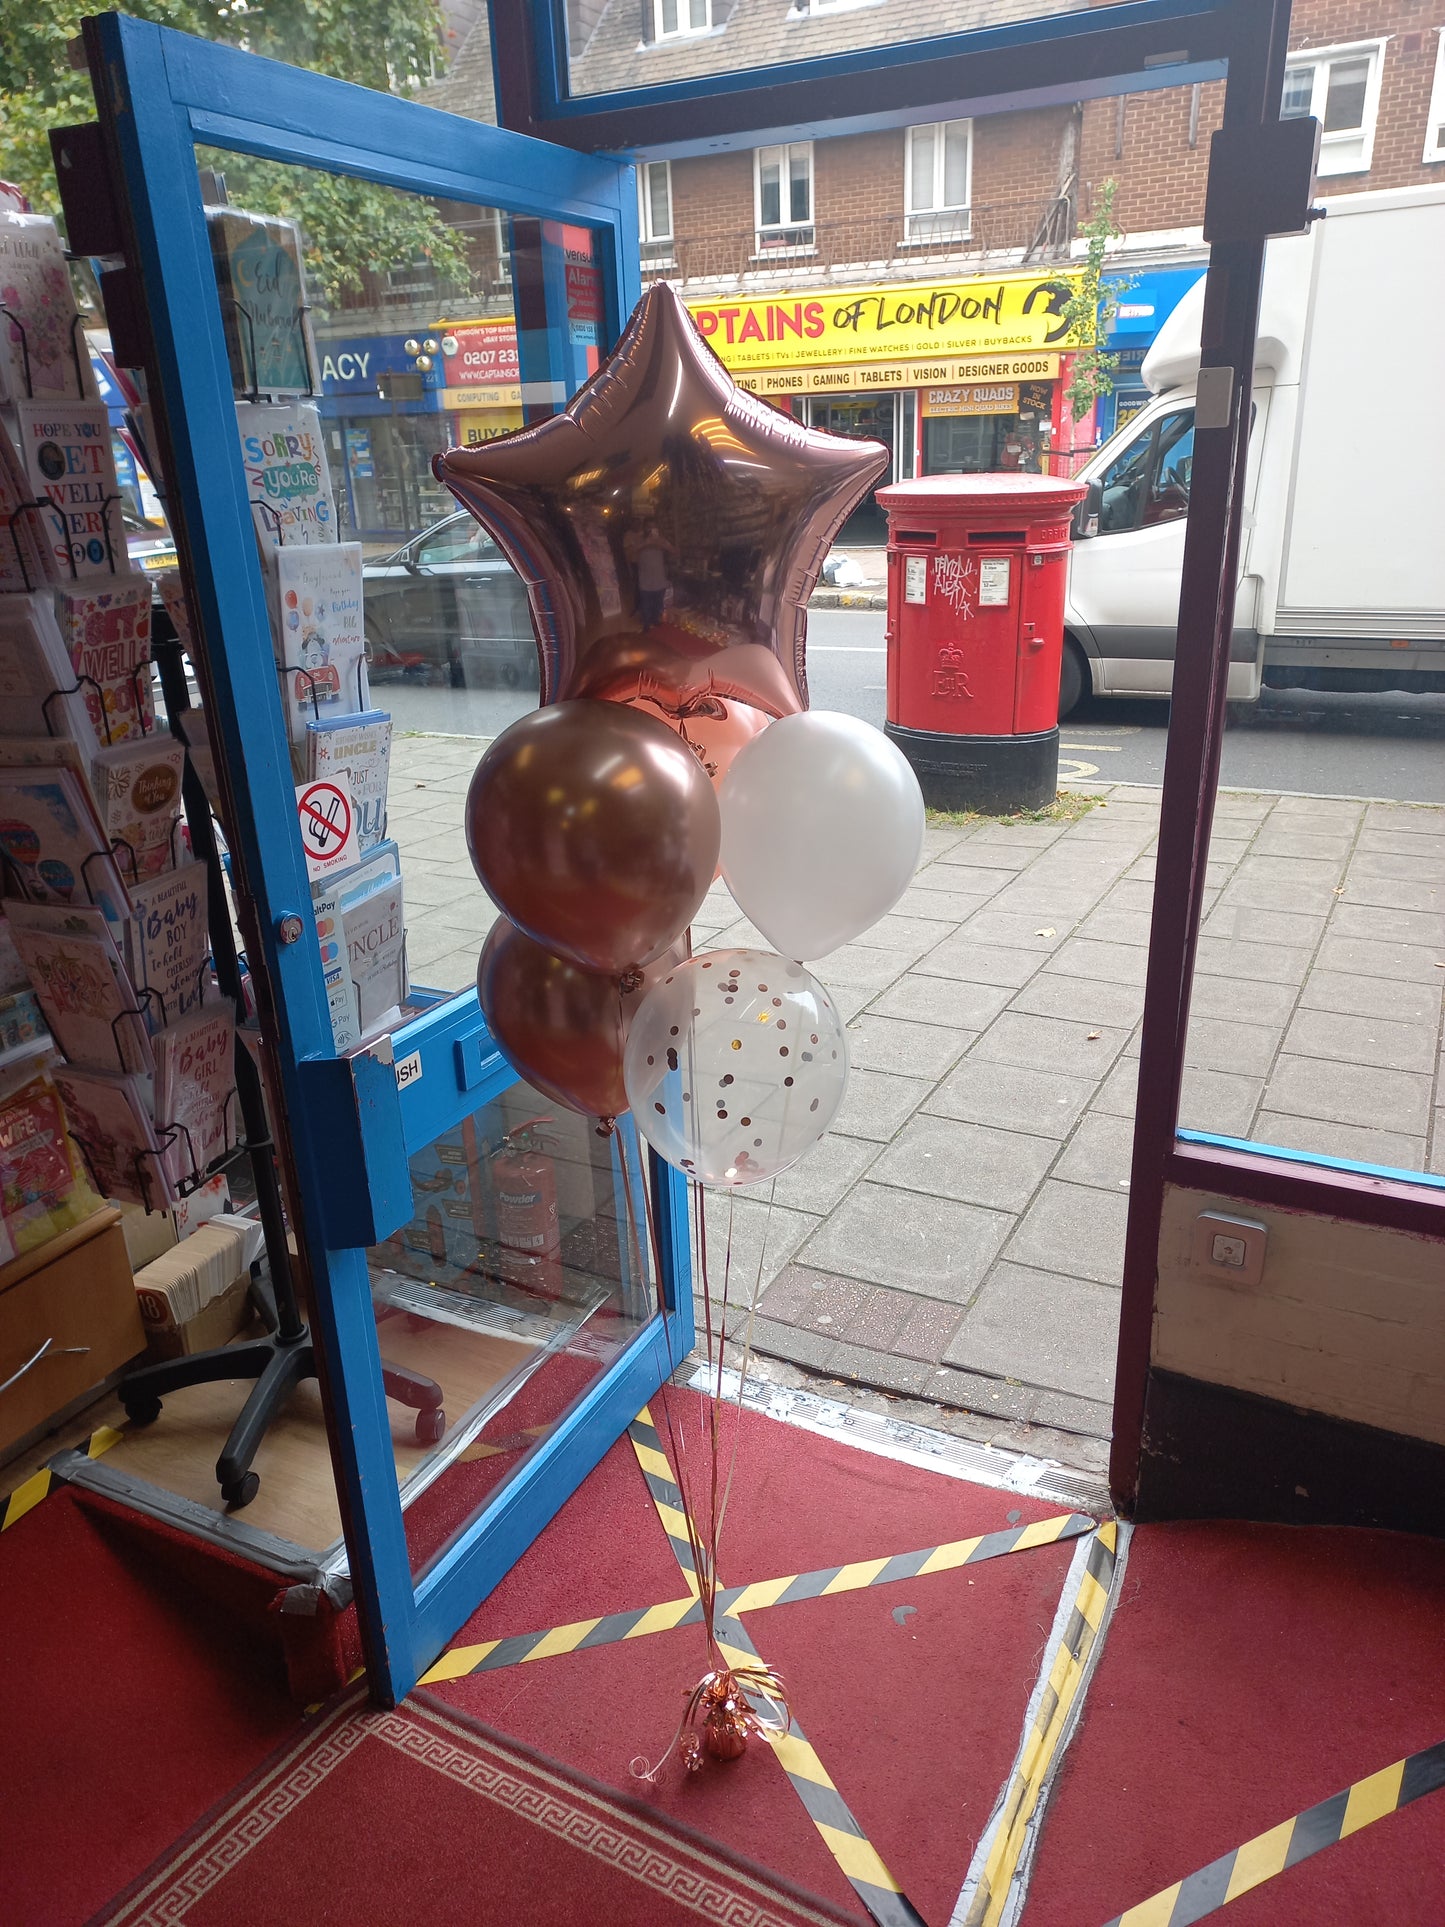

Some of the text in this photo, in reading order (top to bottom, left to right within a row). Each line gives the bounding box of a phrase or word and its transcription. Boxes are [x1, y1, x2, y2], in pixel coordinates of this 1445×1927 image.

[876, 286, 1005, 331] LONDON
[463, 350, 496, 365] 0207
[737, 353, 770, 361] TABLETS
[795, 349, 843, 358] JEWELLERY
[848, 346, 868, 355] FINE
[869, 344, 910, 353] WATCHES
[916, 341, 940, 350] GOLD
[946, 339, 977, 349] SILVER
[983, 335, 1033, 346] BUYBACKS
[766, 376, 803, 389] PHONES
[813, 373, 850, 386] GAMING
[860, 370, 902, 383] TABLETS
[913, 367, 947, 380] VISION
[958, 363, 1009, 377] DESIGNER
[1012, 361, 1049, 374] GOODS
[457, 392, 499, 403] COMPUTING
[928, 389, 970, 404] CRAZY
[1029, 384, 1049, 395] NOW
[1022, 396, 1047, 410] STOCK
[32, 422, 101, 438] HOPE YOU
[467, 428, 498, 443] BUY
[37, 440, 105, 481] GET
[43, 482, 109, 505] WELL
[84, 603, 138, 647] GET
[82, 639, 137, 684] WELL
[333, 739, 377, 761] UNCLE
[352, 768, 370, 786] JUST
[362, 780, 384, 796] FOR
[313, 854, 348, 873] NO SMOKING
[157, 880, 188, 903] BEAUTIFUL
[147, 891, 198, 940] Baby
[166, 921, 188, 948] BOY
[326, 974, 341, 985] VISA
[334, 994, 346, 1006] Pay
[338, 1013, 351, 1027] Pay
[179, 1029, 228, 1075] Baby
[194, 1058, 218, 1082] GIRL
[138, 1293, 161, 1319] 18
